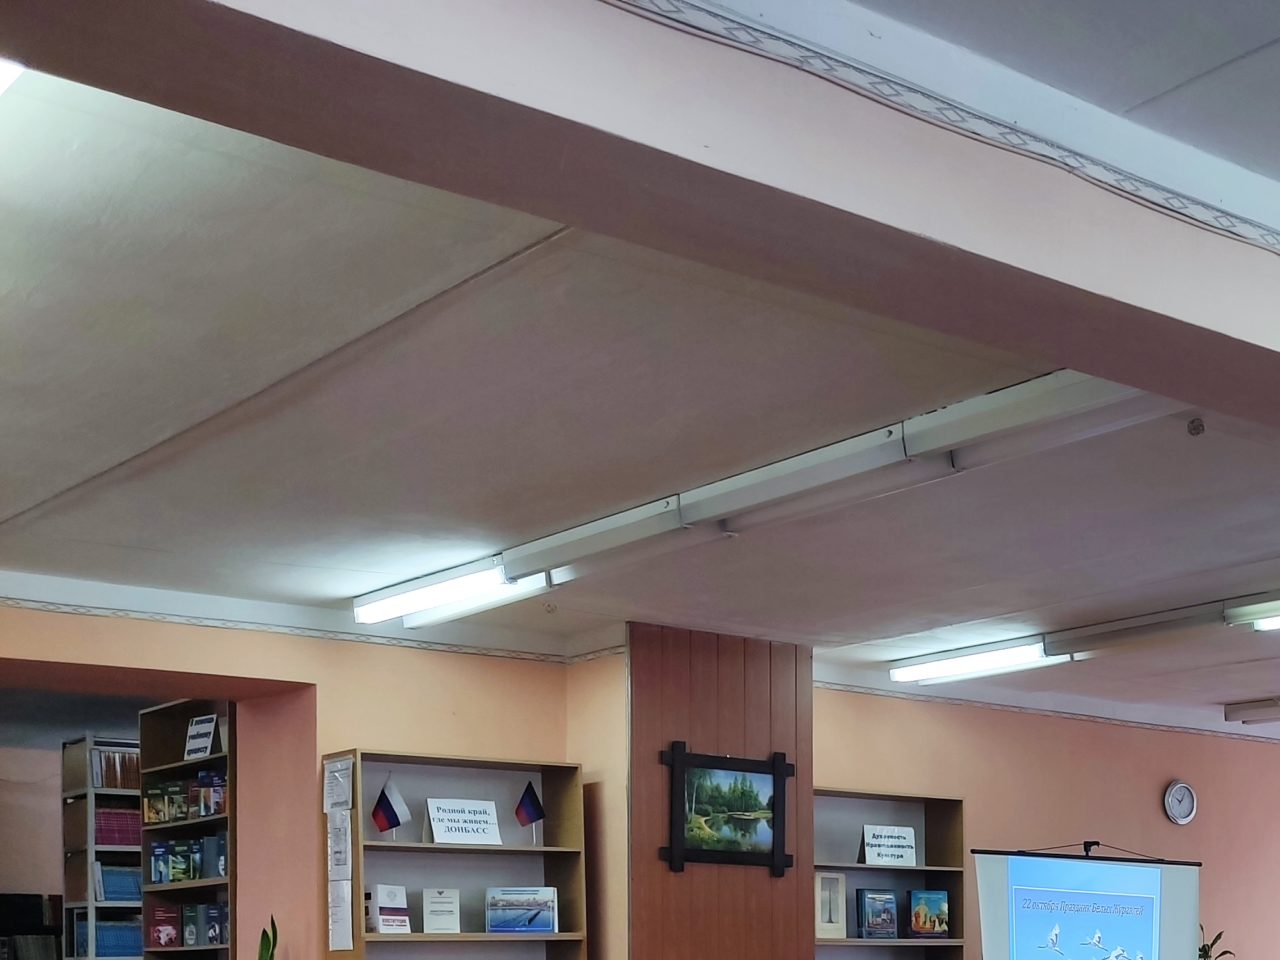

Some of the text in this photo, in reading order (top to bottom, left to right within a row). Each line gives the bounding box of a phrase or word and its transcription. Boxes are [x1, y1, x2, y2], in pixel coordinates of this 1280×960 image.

[436, 806, 491, 817] Родной край,
[444, 825, 489, 834] ДОНБАСС
[1022, 898, 1032, 909] 22
